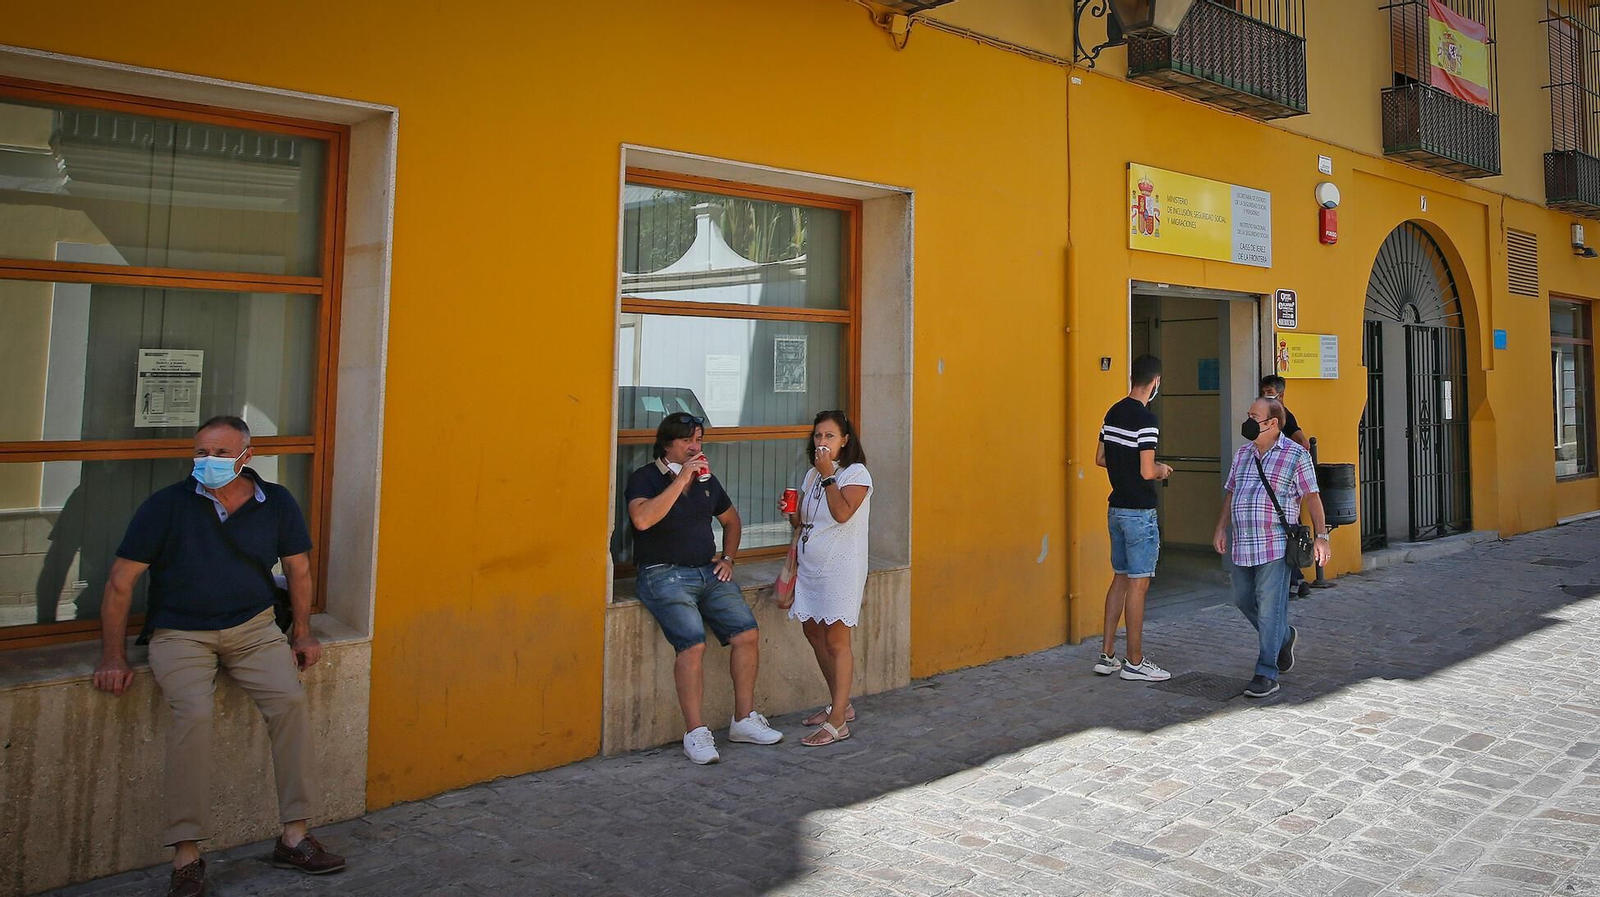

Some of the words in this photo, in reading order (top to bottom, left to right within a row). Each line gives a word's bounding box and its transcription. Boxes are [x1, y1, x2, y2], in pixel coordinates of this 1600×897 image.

[1167, 194, 1188, 206] MINISTERIO
[1167, 206, 1173, 214] DE
[1171, 218, 1197, 228] MIGRACIONES
[1256, 245, 1266, 253] JEREZ
[1249, 254, 1267, 263] FRONTERA
